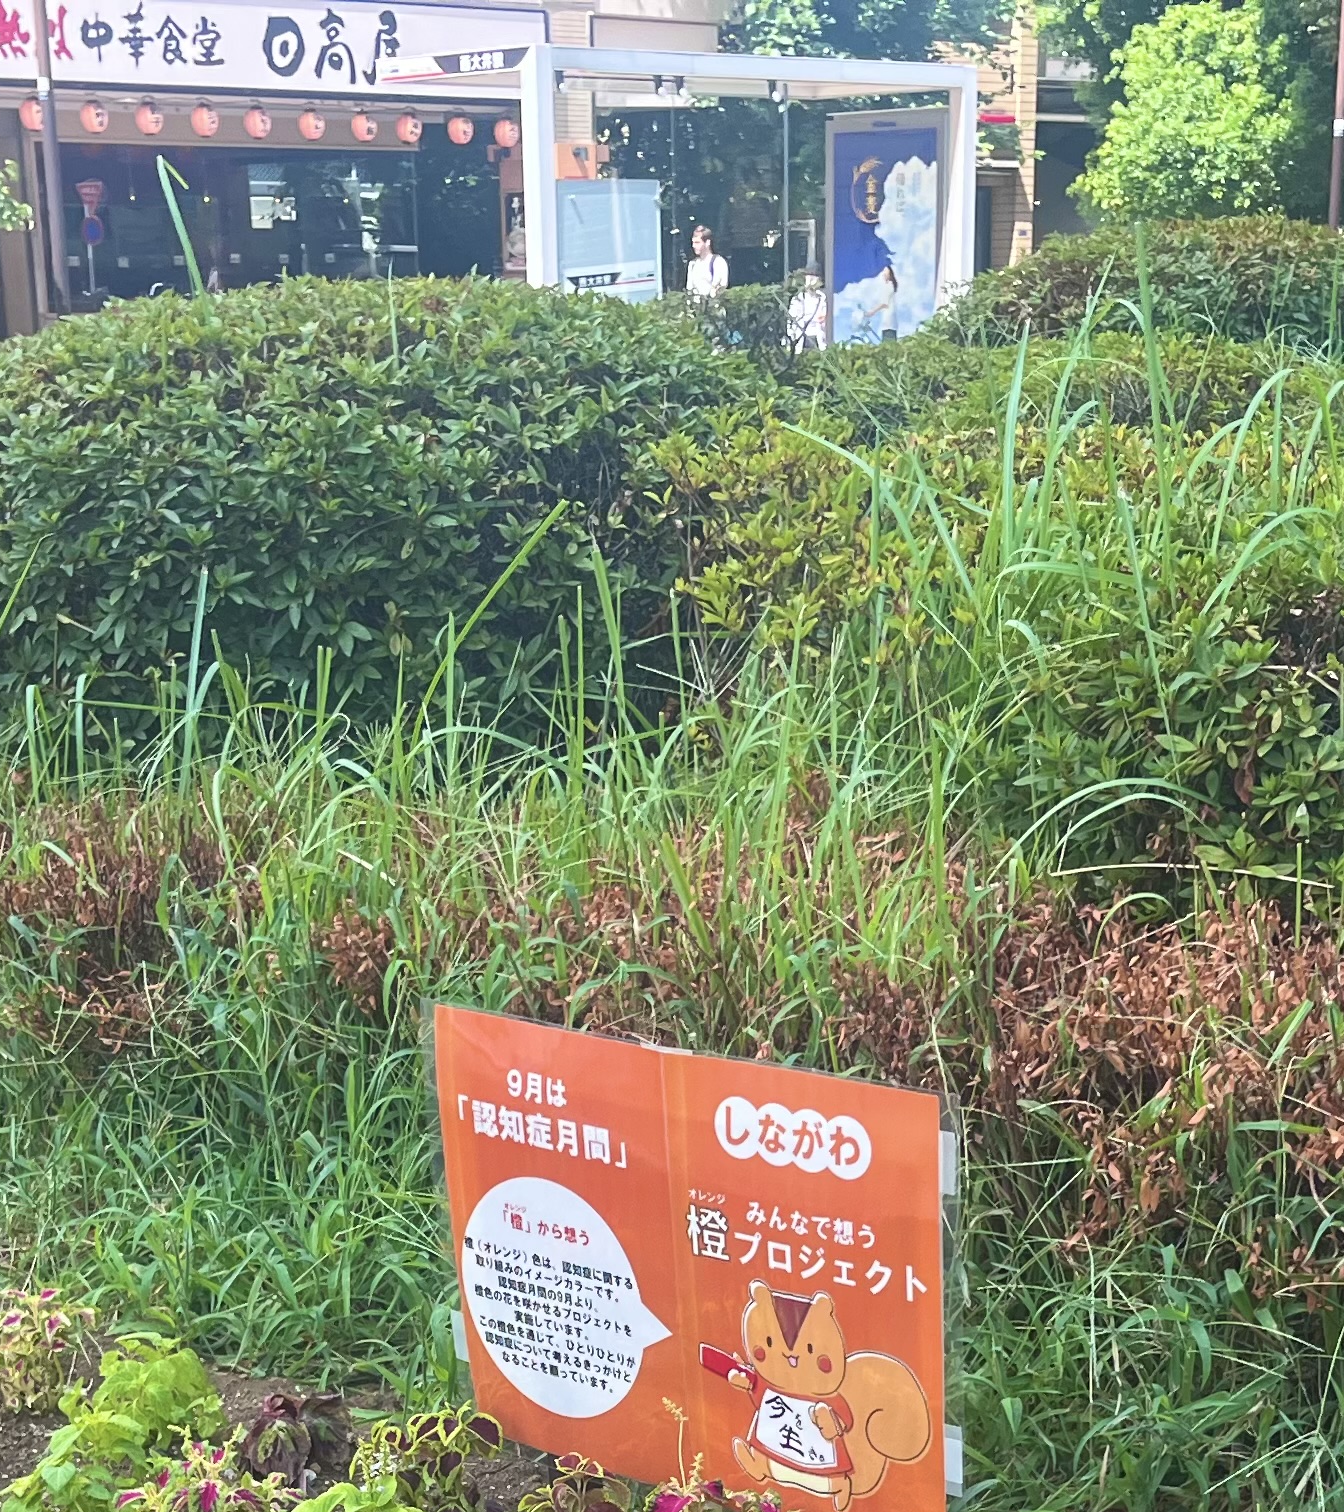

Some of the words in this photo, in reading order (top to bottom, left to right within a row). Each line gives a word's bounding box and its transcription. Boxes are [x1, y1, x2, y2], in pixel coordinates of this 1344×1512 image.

[262, 8, 400, 85] 日高屋
[506, 1068, 567, 1108] 9月は
[457, 1093, 628, 1169] 「認知症月間」
[724, 1105, 862, 1167] しながわ
[688, 1188, 726, 1205] オレンジ
[503, 1209, 590, 1246] 「橙」から想う
[745, 1200, 876, 1250] みんなで想う
[686, 1204, 929, 1303] 橙プロジェクト
[514, 1310, 590, 1341] 実施しています。
[485, 1331, 632, 1383] 認知症について考えるきっかけと
[502, 1351, 613, 1394] なることを願っています。
[764, 1395, 804, 1431] 今を
